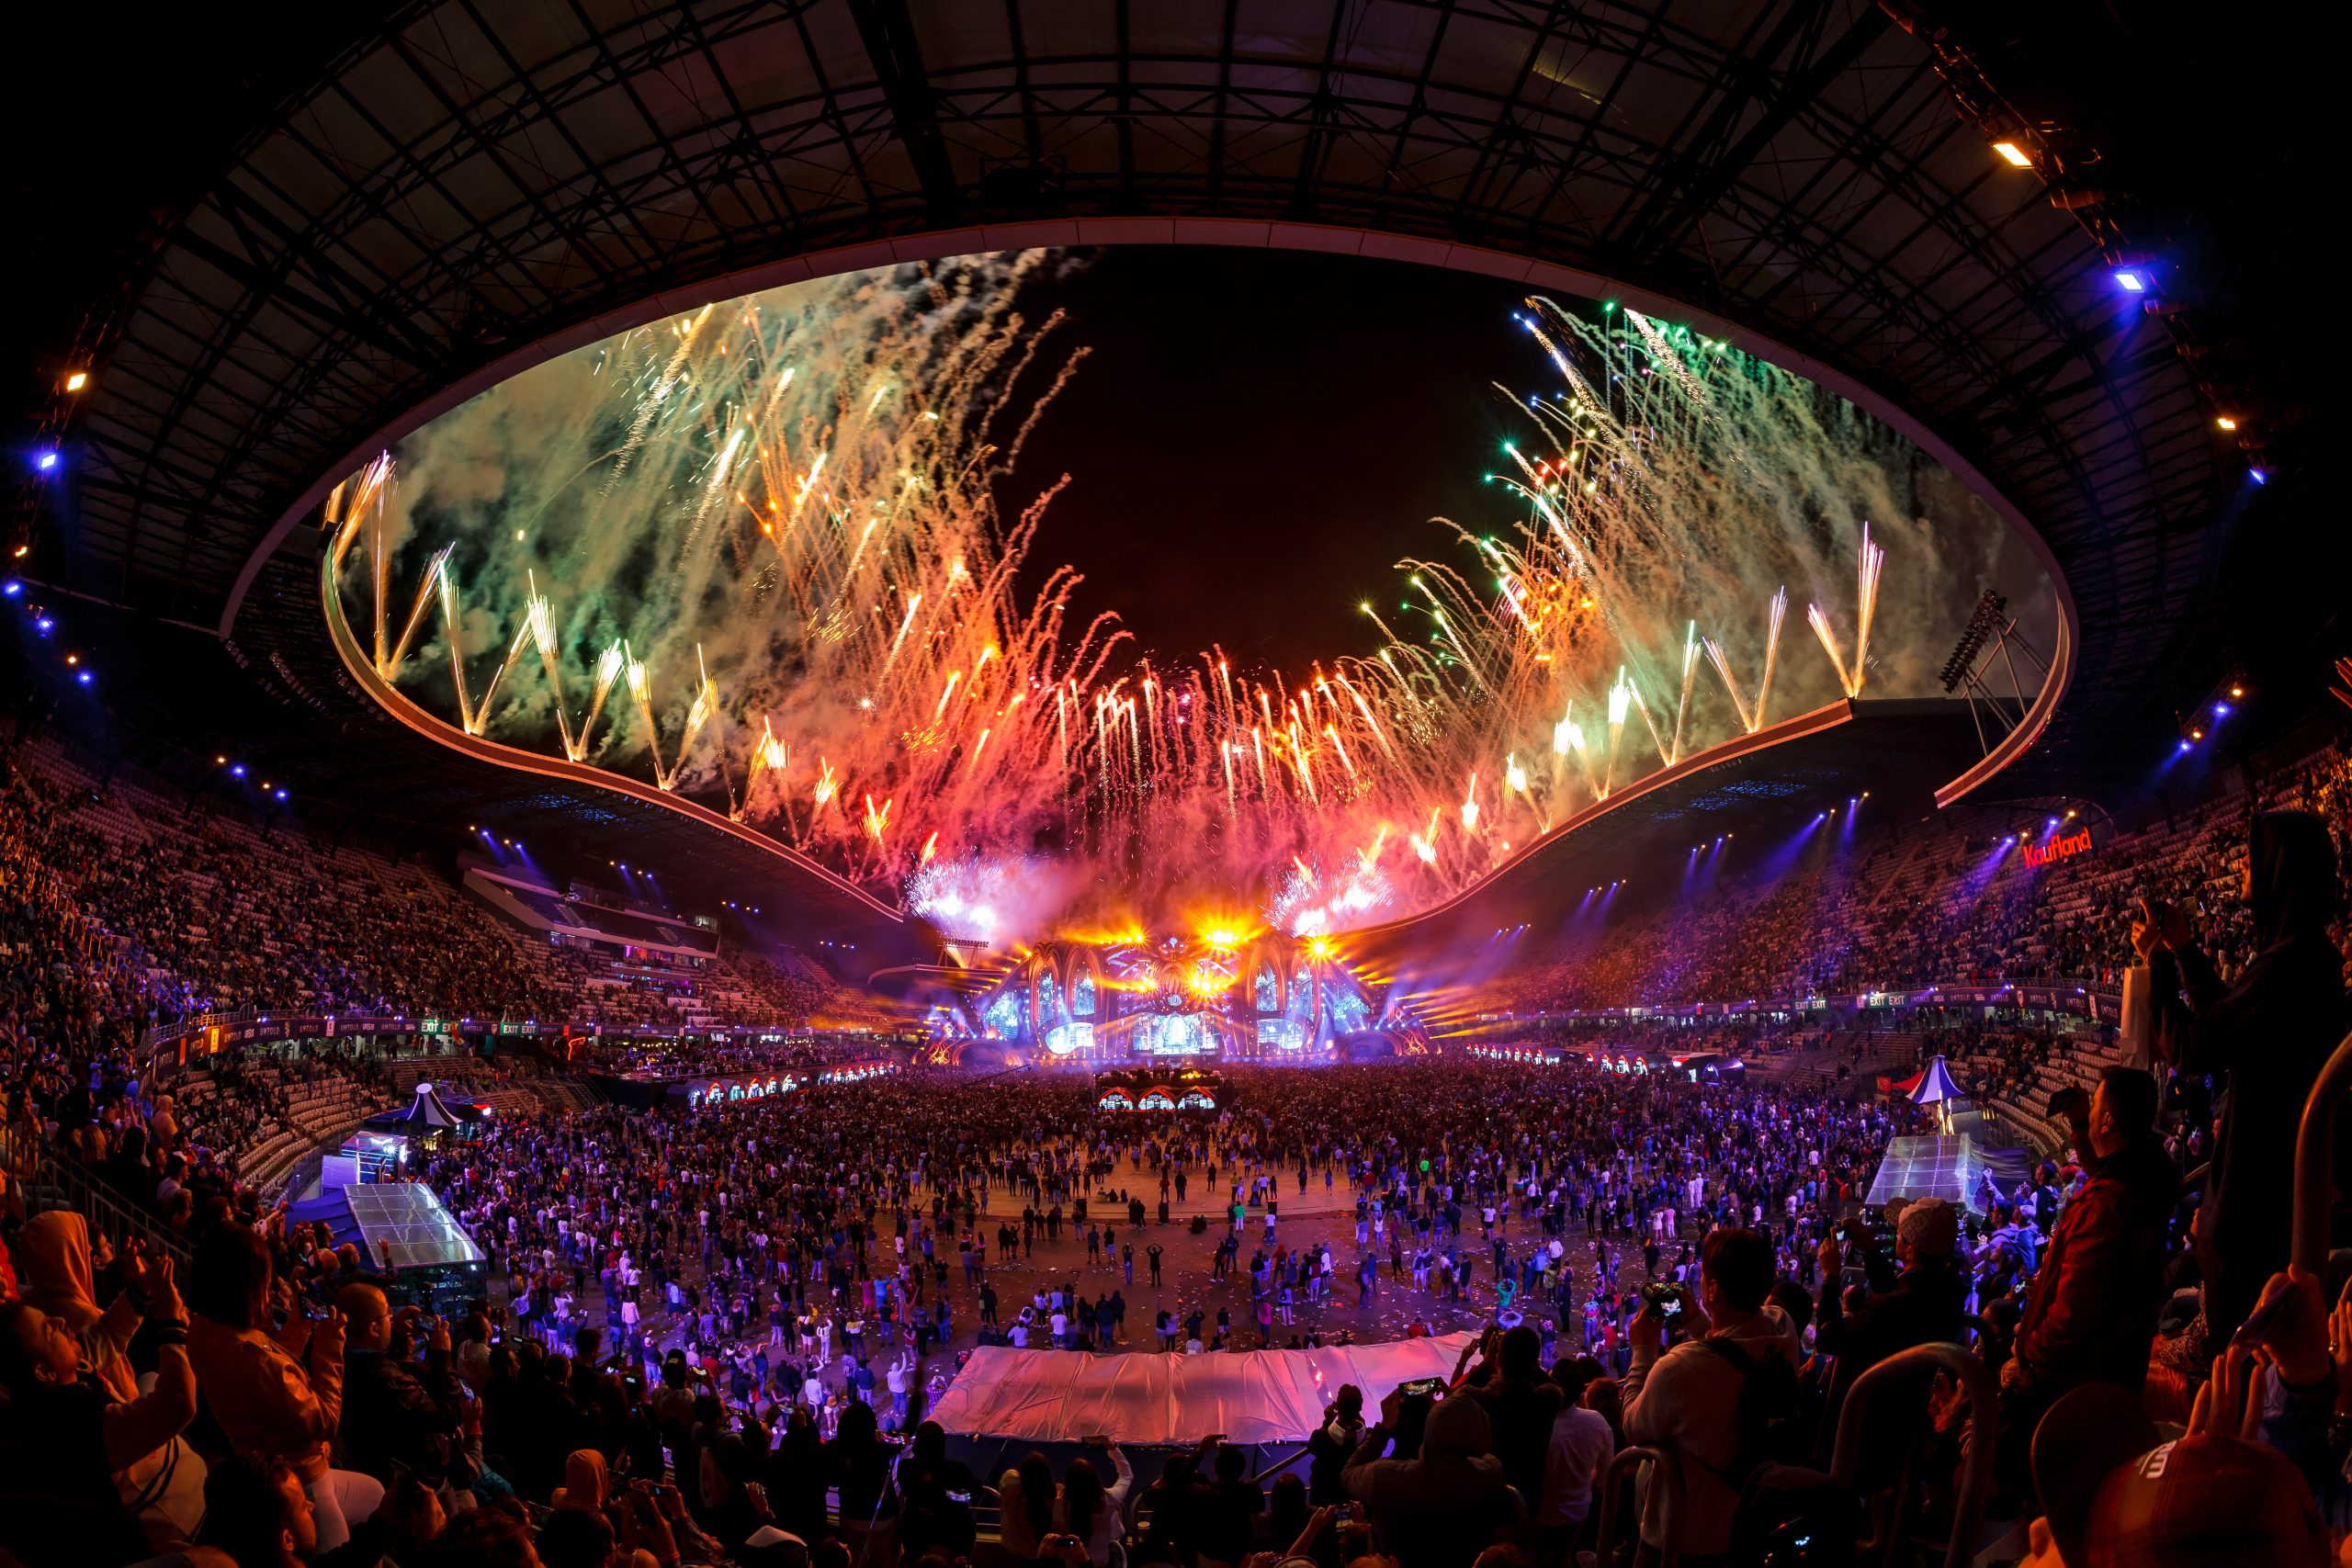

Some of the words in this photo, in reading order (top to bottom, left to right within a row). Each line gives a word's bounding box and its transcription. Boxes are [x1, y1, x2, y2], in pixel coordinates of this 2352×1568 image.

[2023, 827, 2091, 869] Kaufland
[1795, 1000, 1809, 1010] EXIT
[1812, 999, 1826, 1010] EXIT
[1870, 997, 1885, 1007] EXIT
[1888, 995, 1905, 1006] EXIT
[260, 1026, 280, 1036] UNTOLD
[421, 1021, 439, 1032] EXIT
[442, 1022, 458, 1032] EX
[503, 1024, 519, 1033] EXIT
[521, 1025, 537, 1034] EXIT
